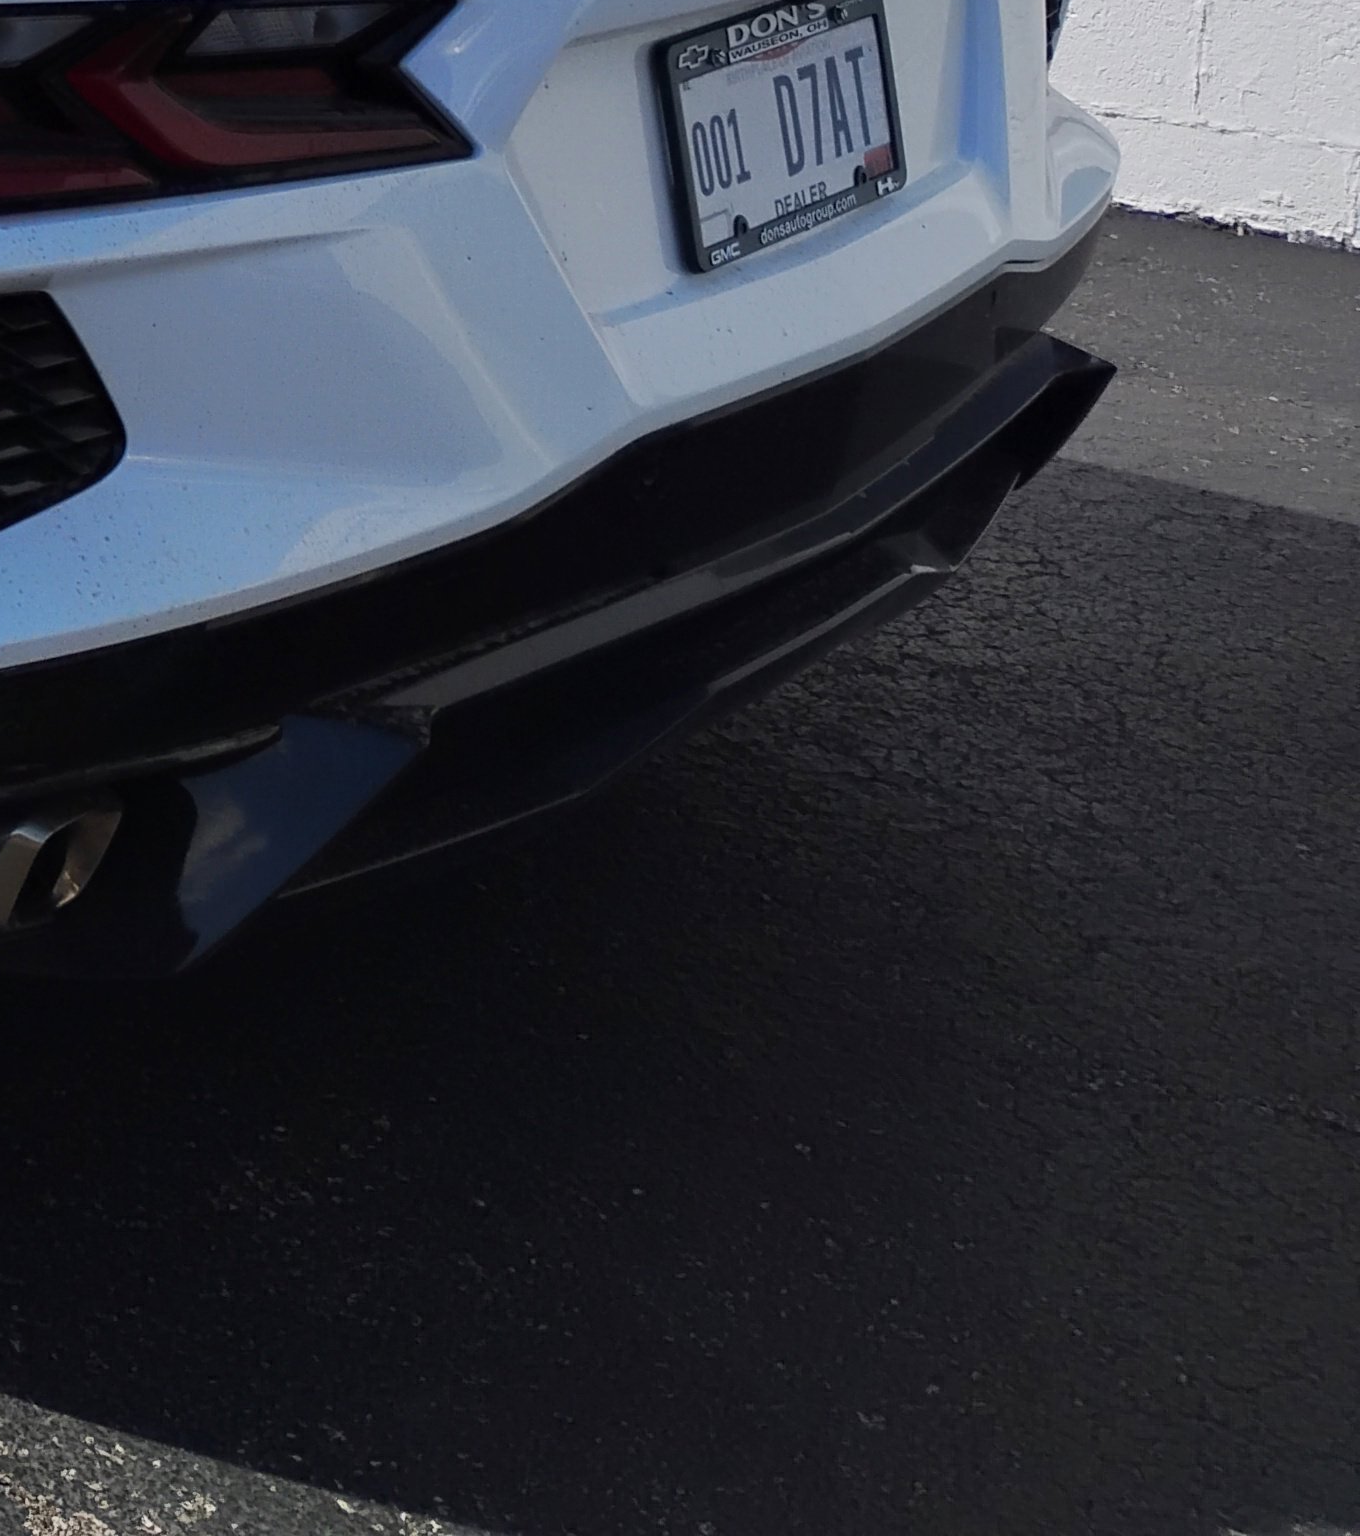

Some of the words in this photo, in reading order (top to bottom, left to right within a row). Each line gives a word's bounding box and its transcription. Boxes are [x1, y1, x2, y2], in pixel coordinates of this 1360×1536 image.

[727, 3, 826, 47] DON'S
[730, 29, 804, 59] WAUSEON,
[806, 18, 828, 32] OH
[692, 108, 751, 196] 001
[773, 46, 871, 177] D7AT
[760, 192, 857, 244] donsautogroup.com
[775, 181, 828, 216] DEALER
[711, 242, 742, 265] GMC
